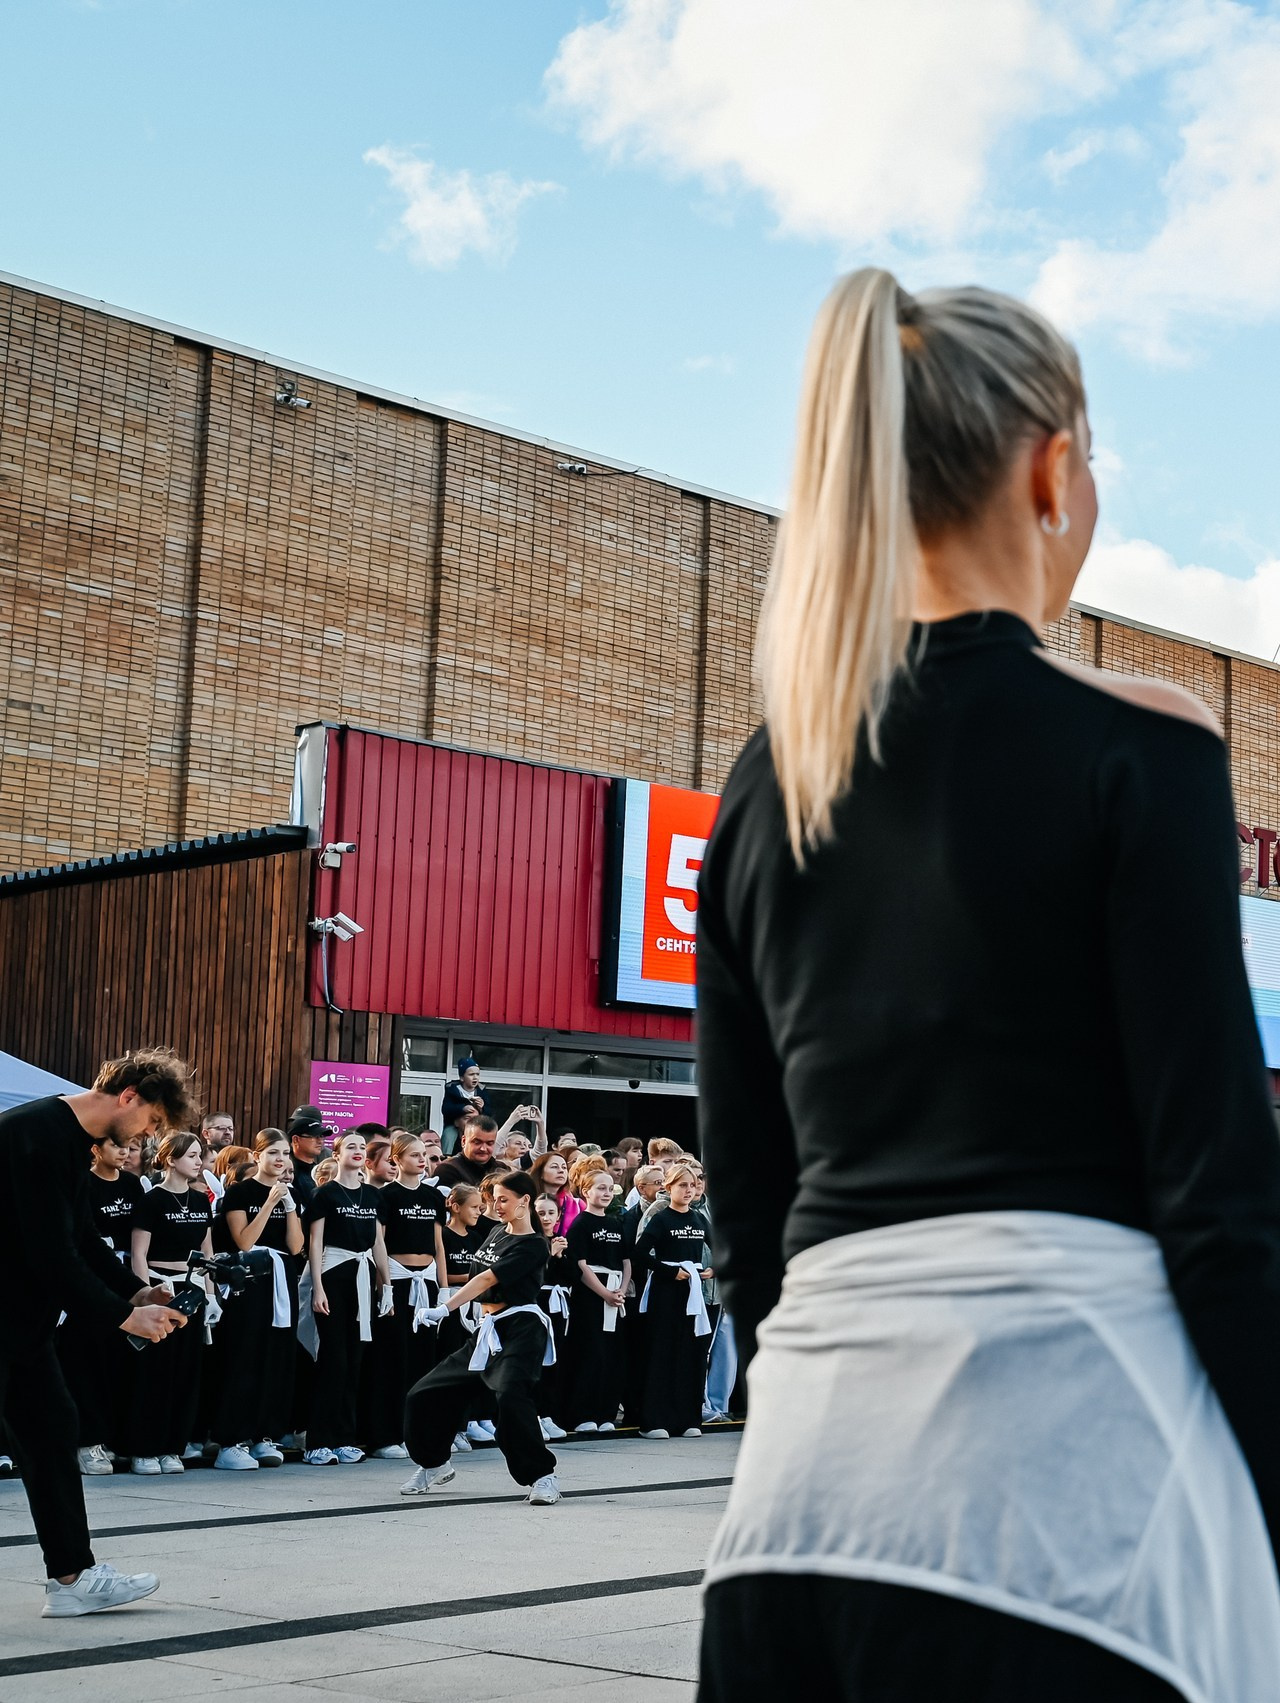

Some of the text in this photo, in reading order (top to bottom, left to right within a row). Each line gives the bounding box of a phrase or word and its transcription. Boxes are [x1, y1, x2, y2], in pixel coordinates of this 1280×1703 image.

[663, 833, 710, 934] 5
[165, 1212, 186, 1220] TANZ
[399, 1208, 417, 1216] TANZ
